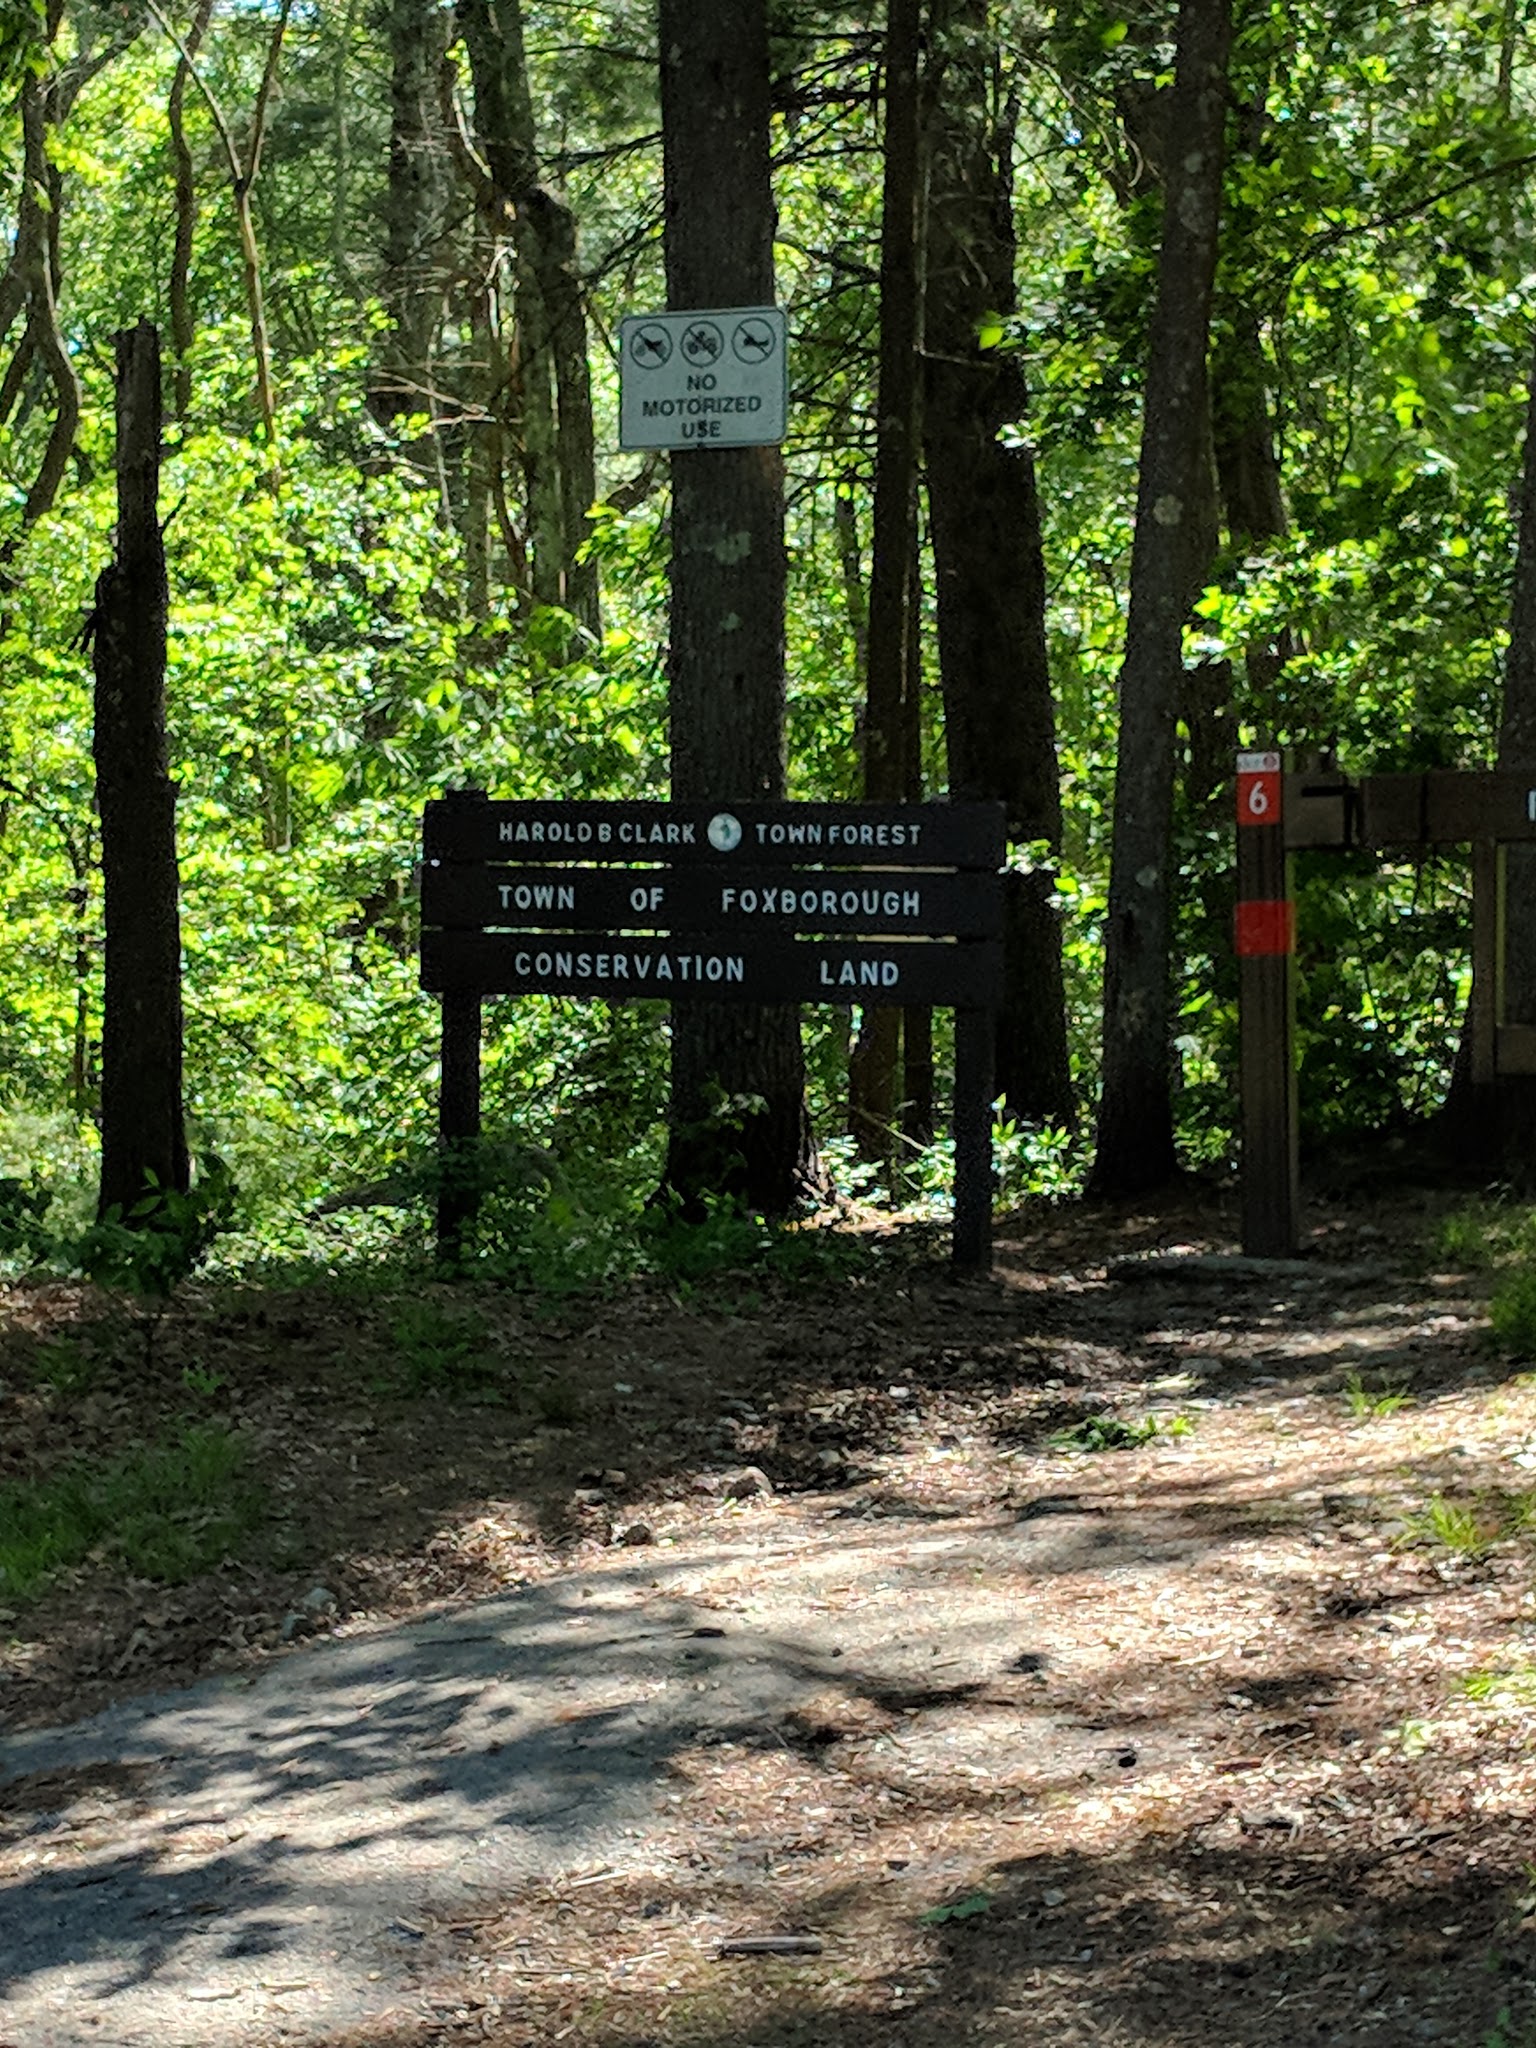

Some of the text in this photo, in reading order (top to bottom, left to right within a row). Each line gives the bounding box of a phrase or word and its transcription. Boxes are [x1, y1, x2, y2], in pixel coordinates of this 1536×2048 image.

[687, 374, 717, 391] NO
[642, 396, 762, 417] MOTORIZED
[681, 420, 721, 438] USE
[1248, 781, 1268, 815] 6
[499, 821, 922, 846] HAROLD B CLARK TOWN FOREST
[498, 885, 920, 917] TOWN OF FOXBOROUGH
[515, 951, 899, 986] CONSERVATION LAND
